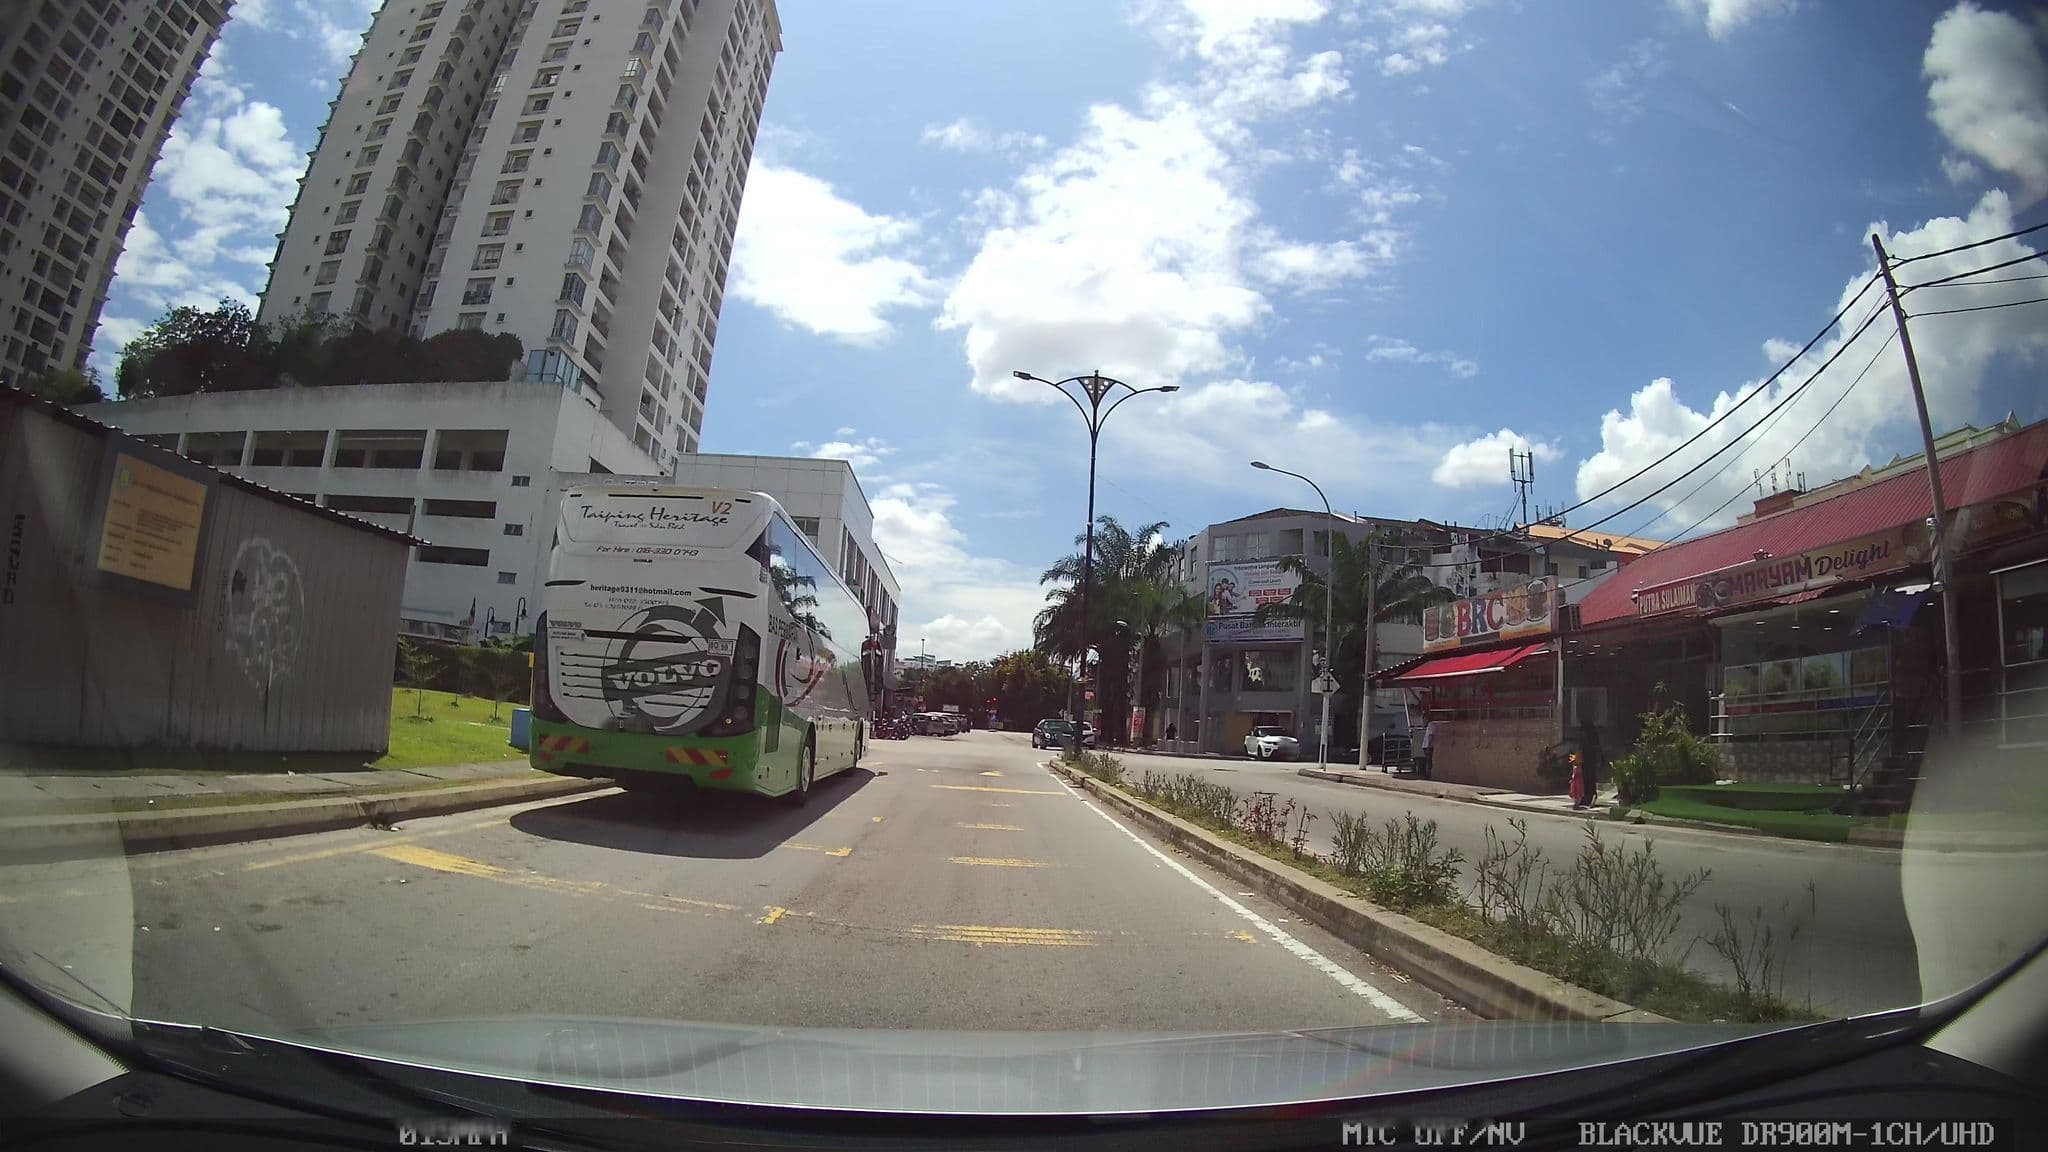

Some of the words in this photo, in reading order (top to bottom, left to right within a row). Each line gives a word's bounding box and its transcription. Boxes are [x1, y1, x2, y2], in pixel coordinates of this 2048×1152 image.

[581, 505, 645, 523] Taiping
[650, 506, 730, 526] Heritage
[712, 501, 733, 515] V2
[1728, 556, 1813, 597] MARYAM
[1814, 541, 1892, 577] Delight
[1456, 597, 1505, 637] BRC
[1639, 591, 1661, 615] PUTRA
[607, 659, 722, 691] VOLVO
